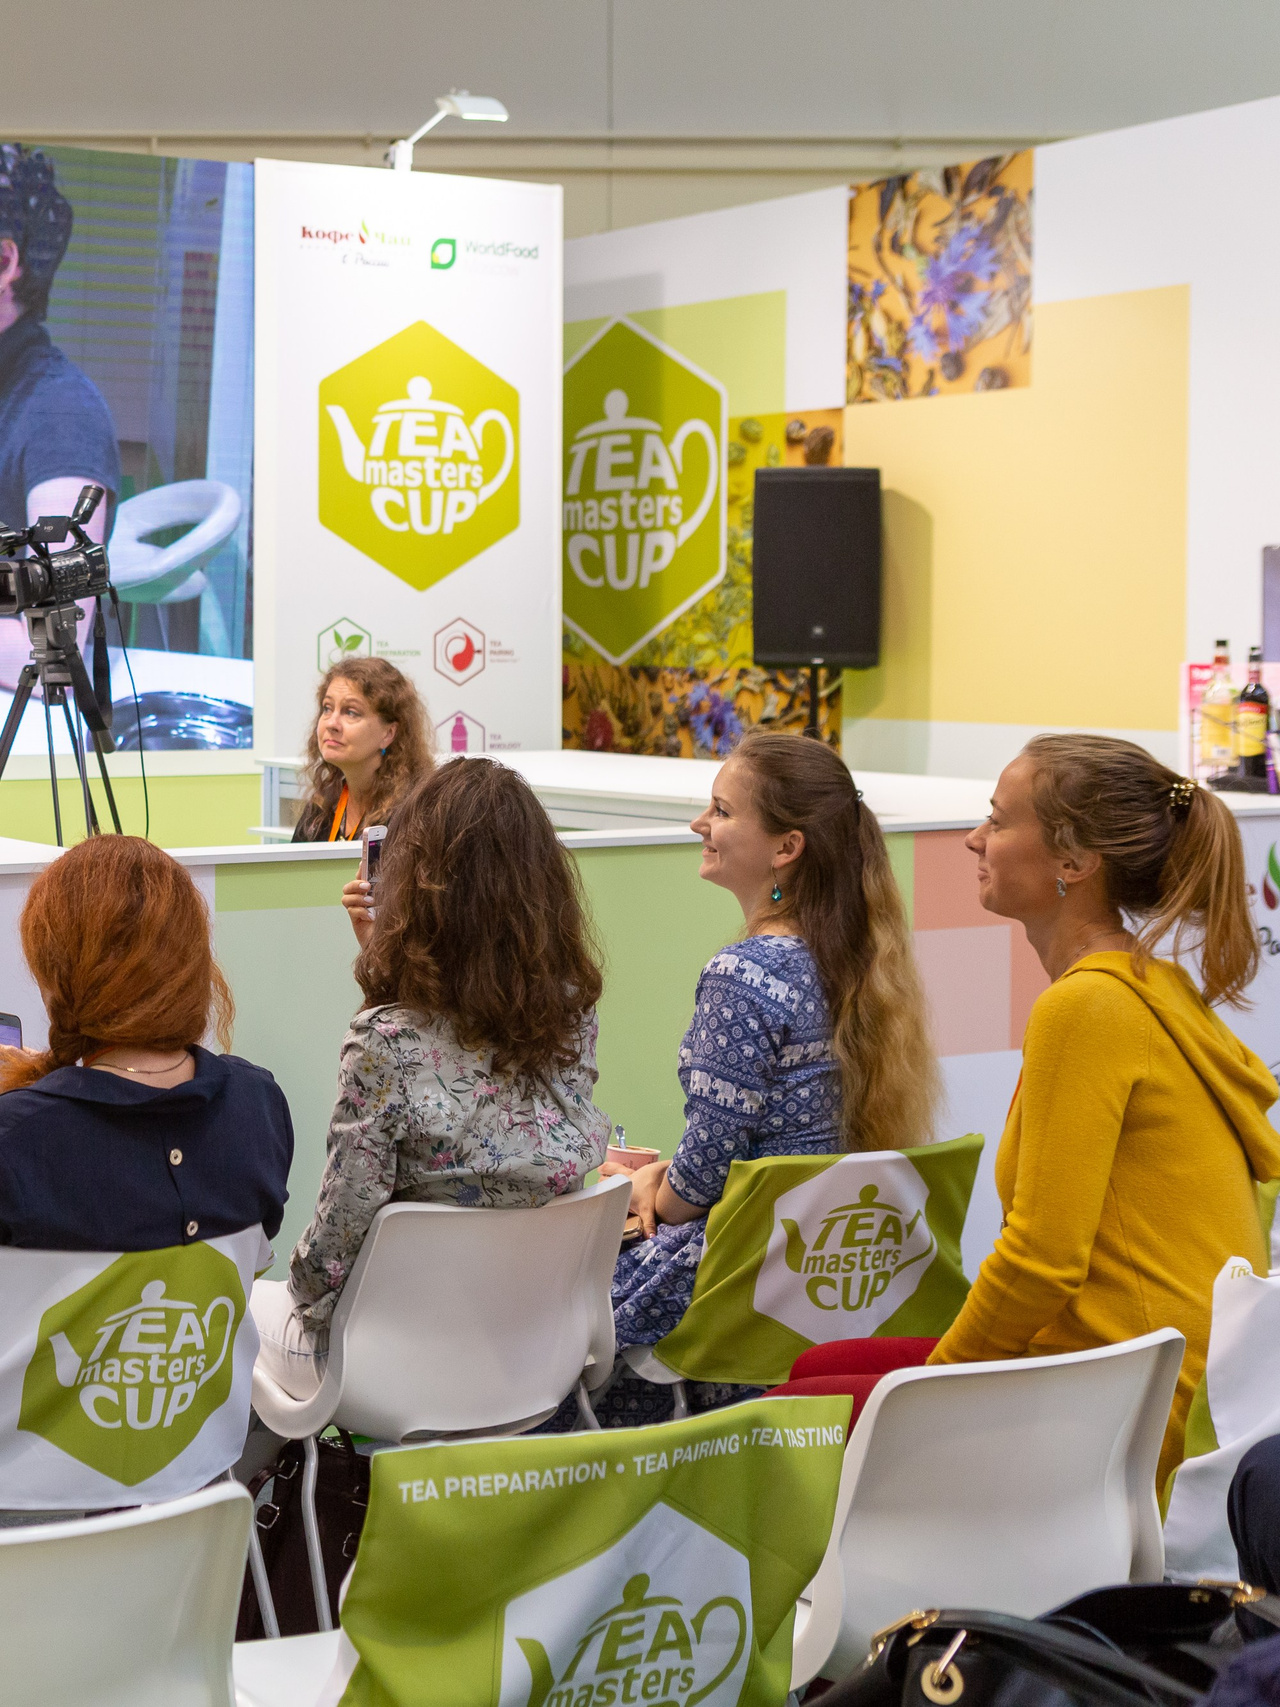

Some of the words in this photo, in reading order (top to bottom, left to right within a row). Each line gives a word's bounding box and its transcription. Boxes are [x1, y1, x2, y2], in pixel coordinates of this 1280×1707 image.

[465, 240, 540, 259] WorldFood
[370, 410, 480, 461] TEA
[365, 457, 484, 488] masters
[567, 433, 679, 496] TEA
[370, 487, 479, 535] CUP
[563, 490, 683, 531] masters
[568, 530, 677, 590] CUP
[811, 1211, 903, 1251] TEA
[803, 1247, 902, 1275] masters
[805, 1271, 891, 1312] CUP
[88, 1310, 205, 1361] TEA
[76, 1352, 206, 1386] masters
[78, 1382, 198, 1431] CUP
[398, 1478, 439, 1504] TEA
[444, 1460, 608, 1500] PREPARATION
[633, 1451, 669, 1477] TEA
[672, 1433, 740, 1468] PAIRING
[751, 1427, 784, 1448] TEA
[784, 1424, 844, 1449] TASTING
[558, 1609, 693, 1685] TEA
[547, 1664, 696, 1707] masters
